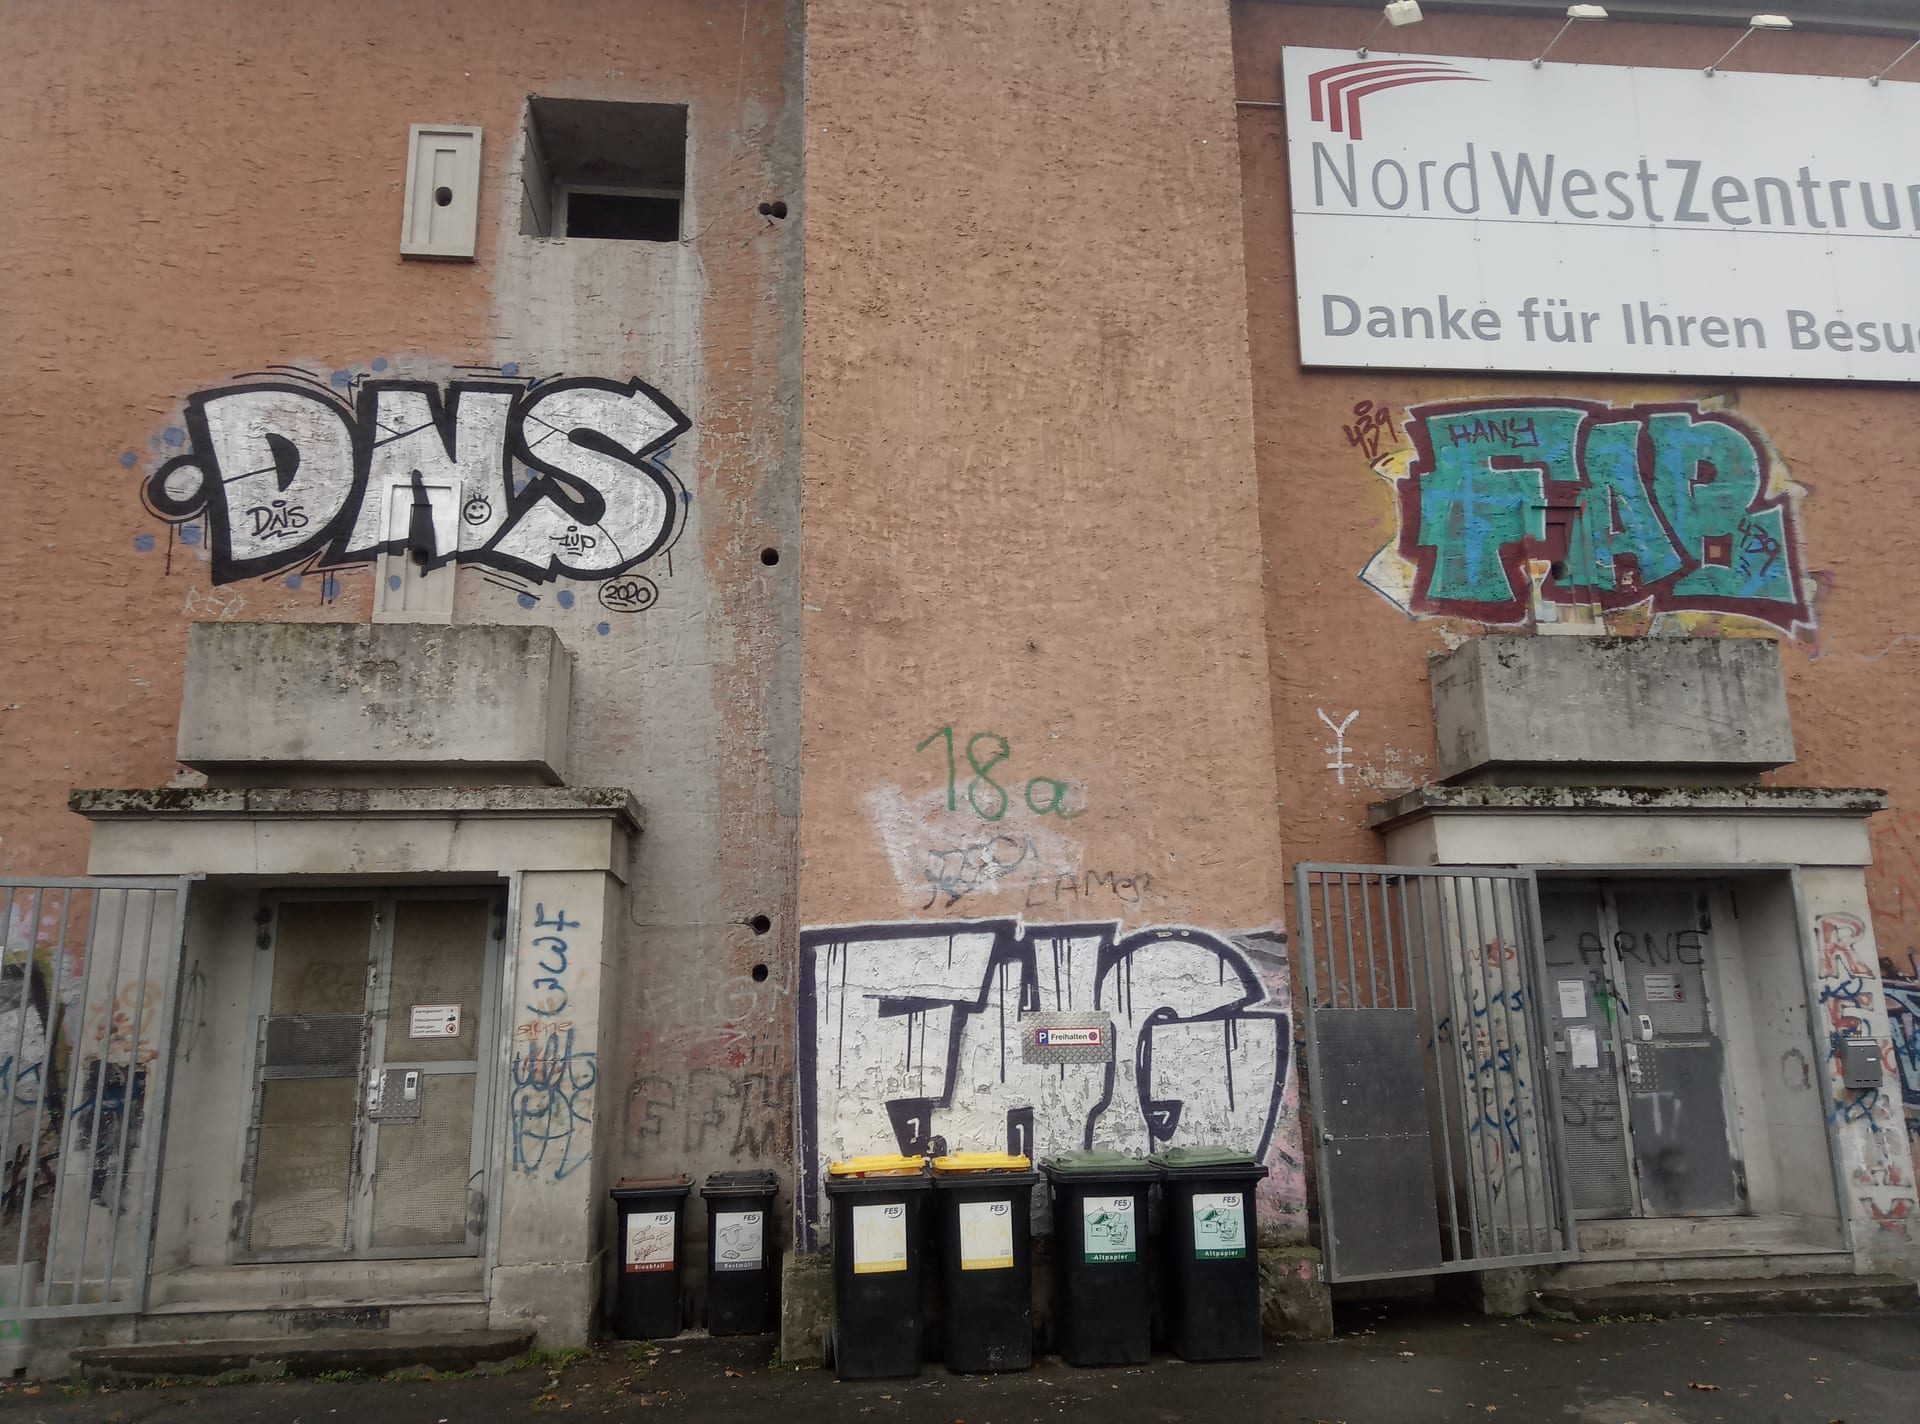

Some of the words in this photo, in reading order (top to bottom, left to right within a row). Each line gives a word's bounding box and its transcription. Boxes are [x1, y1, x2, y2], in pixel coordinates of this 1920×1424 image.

[1322, 294, 1501, 342] Danke
[1517, 298, 1601, 344] für
[1622, 302, 1767, 349] Ihren
[1786, 309, 1920, 354] Besu
[148, 376, 692, 586] DNS
[246, 505, 309, 537] DNS
[1039, 1032, 1047, 1042] P
[1051, 1033, 1088, 1041] Freihalten
[1093, 1253, 1128, 1262] Altpapier
[1203, 1249, 1239, 1258] Altpapier
